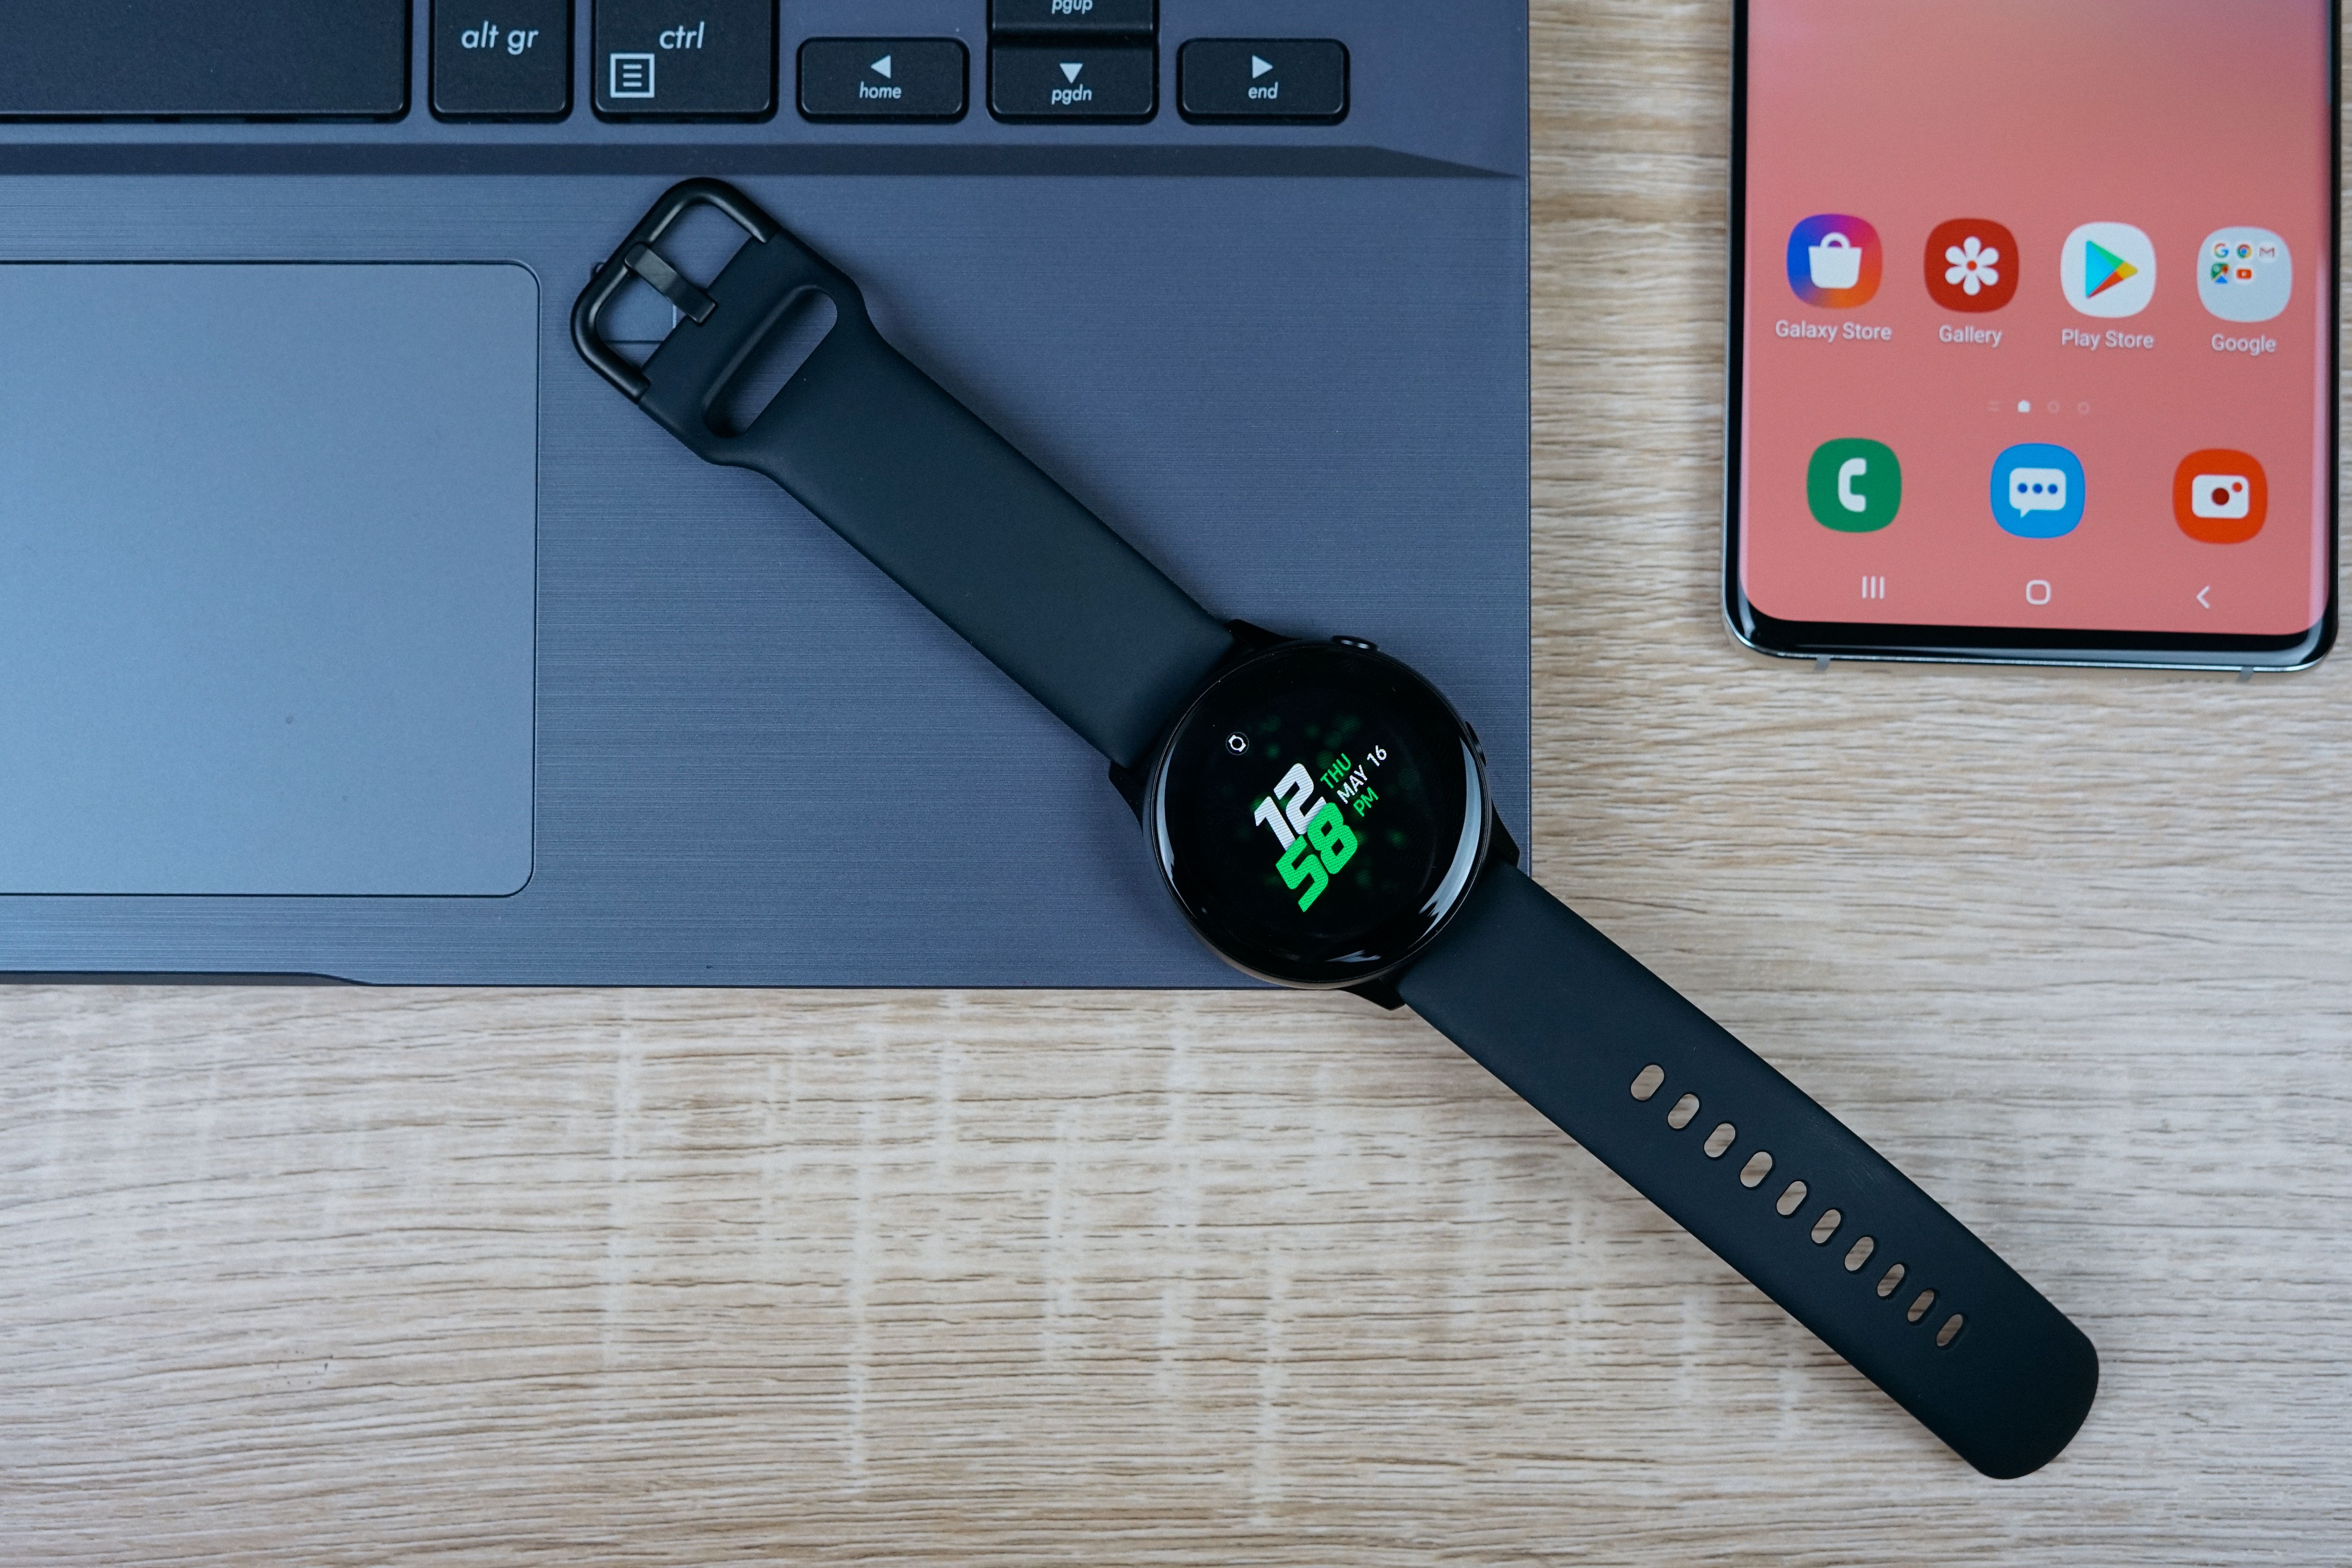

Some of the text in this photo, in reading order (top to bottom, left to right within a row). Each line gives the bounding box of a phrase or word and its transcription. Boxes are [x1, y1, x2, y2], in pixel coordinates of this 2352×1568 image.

[1051, 0, 1093, 15] pgup
[461, 20, 539, 56] alt gr
[659, 21, 705, 49] ctrl
[859, 81, 902, 99] home
[1051, 84, 1093, 105] pgdn
[1248, 81, 1279, 100] end
[1775, 320, 1892, 343] Galaxy Store
[1938, 324, 2003, 348] Gallery
[2061, 328, 2155, 351] Play Store
[2211, 333, 2277, 356] Google
[1320, 753, 1352, 789] THU
[1337, 745, 1387, 804] MAY 16
[1254, 763, 1327, 851] 12
[1353, 787, 1379, 817] PM
[1276, 802, 1358, 913] 58
